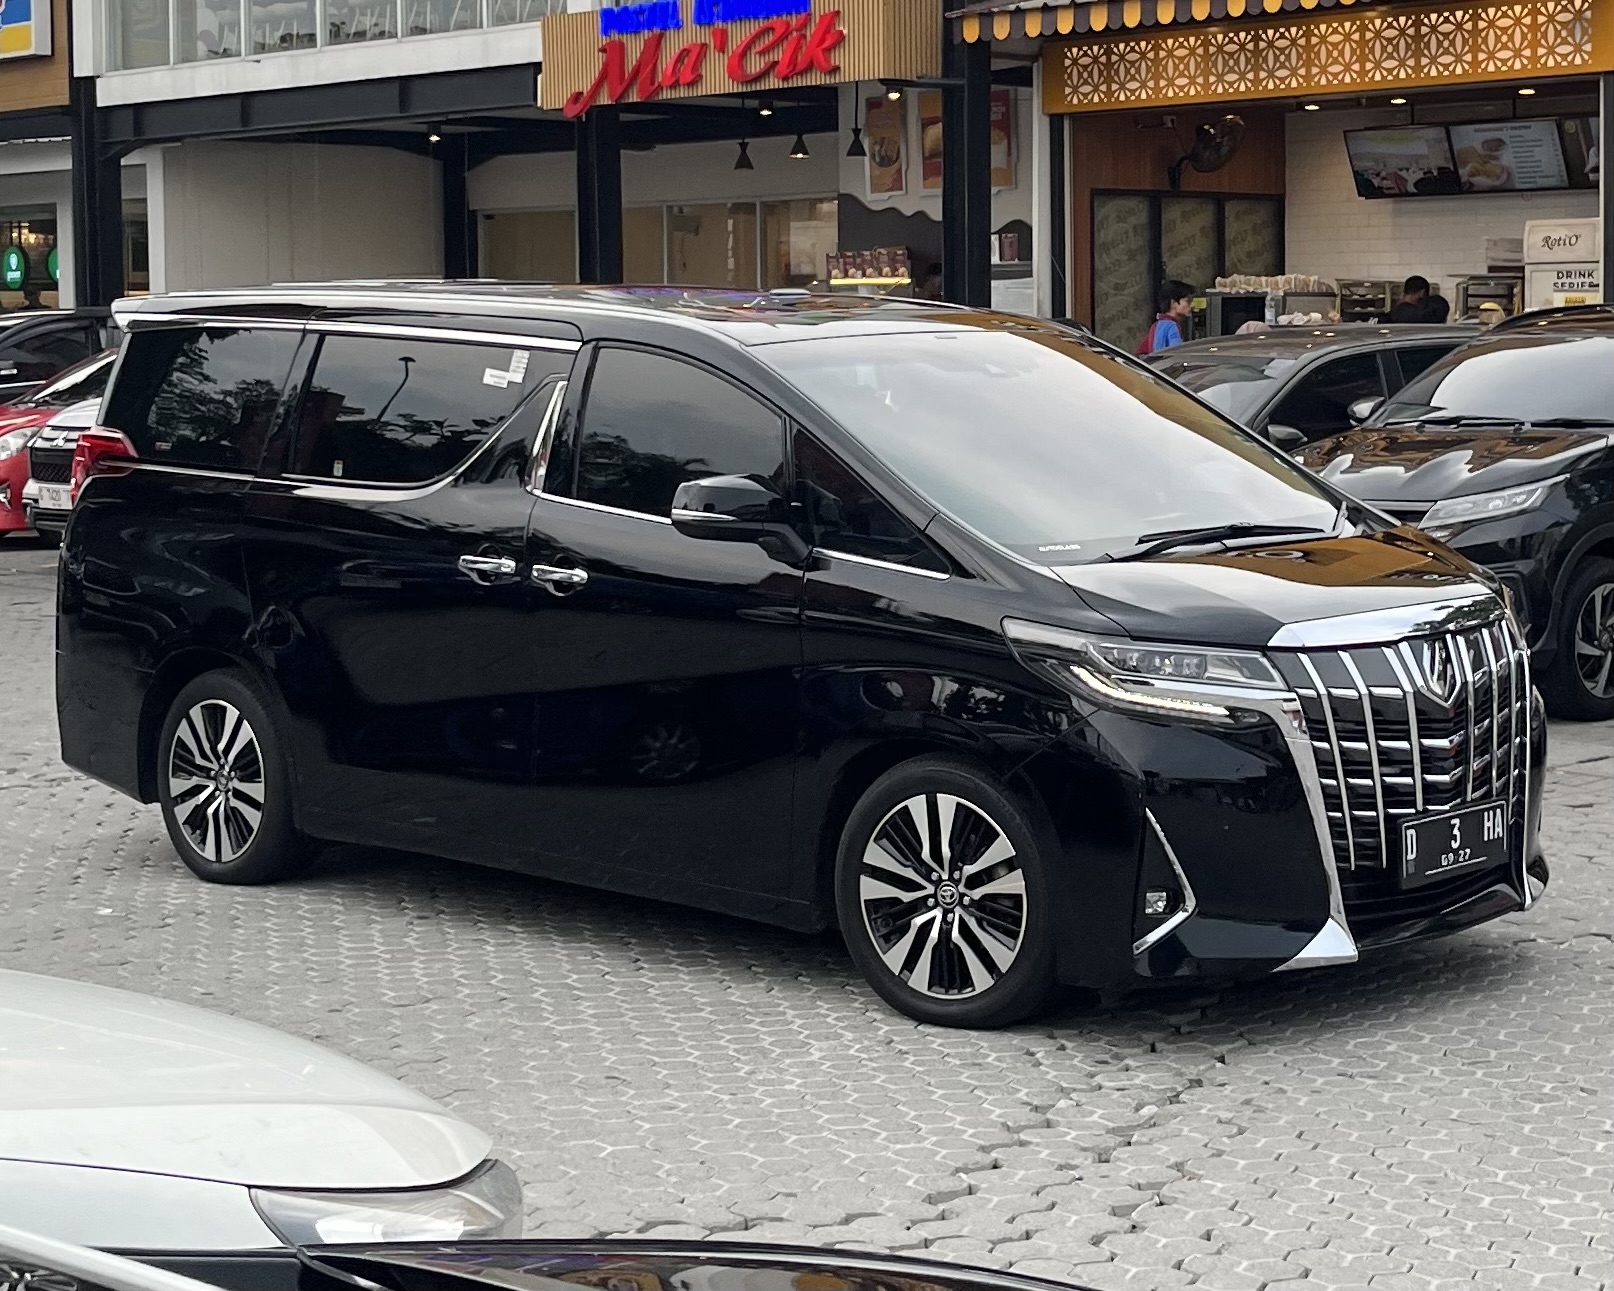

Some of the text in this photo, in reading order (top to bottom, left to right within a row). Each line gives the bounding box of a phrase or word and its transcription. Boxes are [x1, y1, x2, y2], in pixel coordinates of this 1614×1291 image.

[1556, 270, 1595, 280] DRINK
[1406, 808, 1504, 861] D 3 HA
